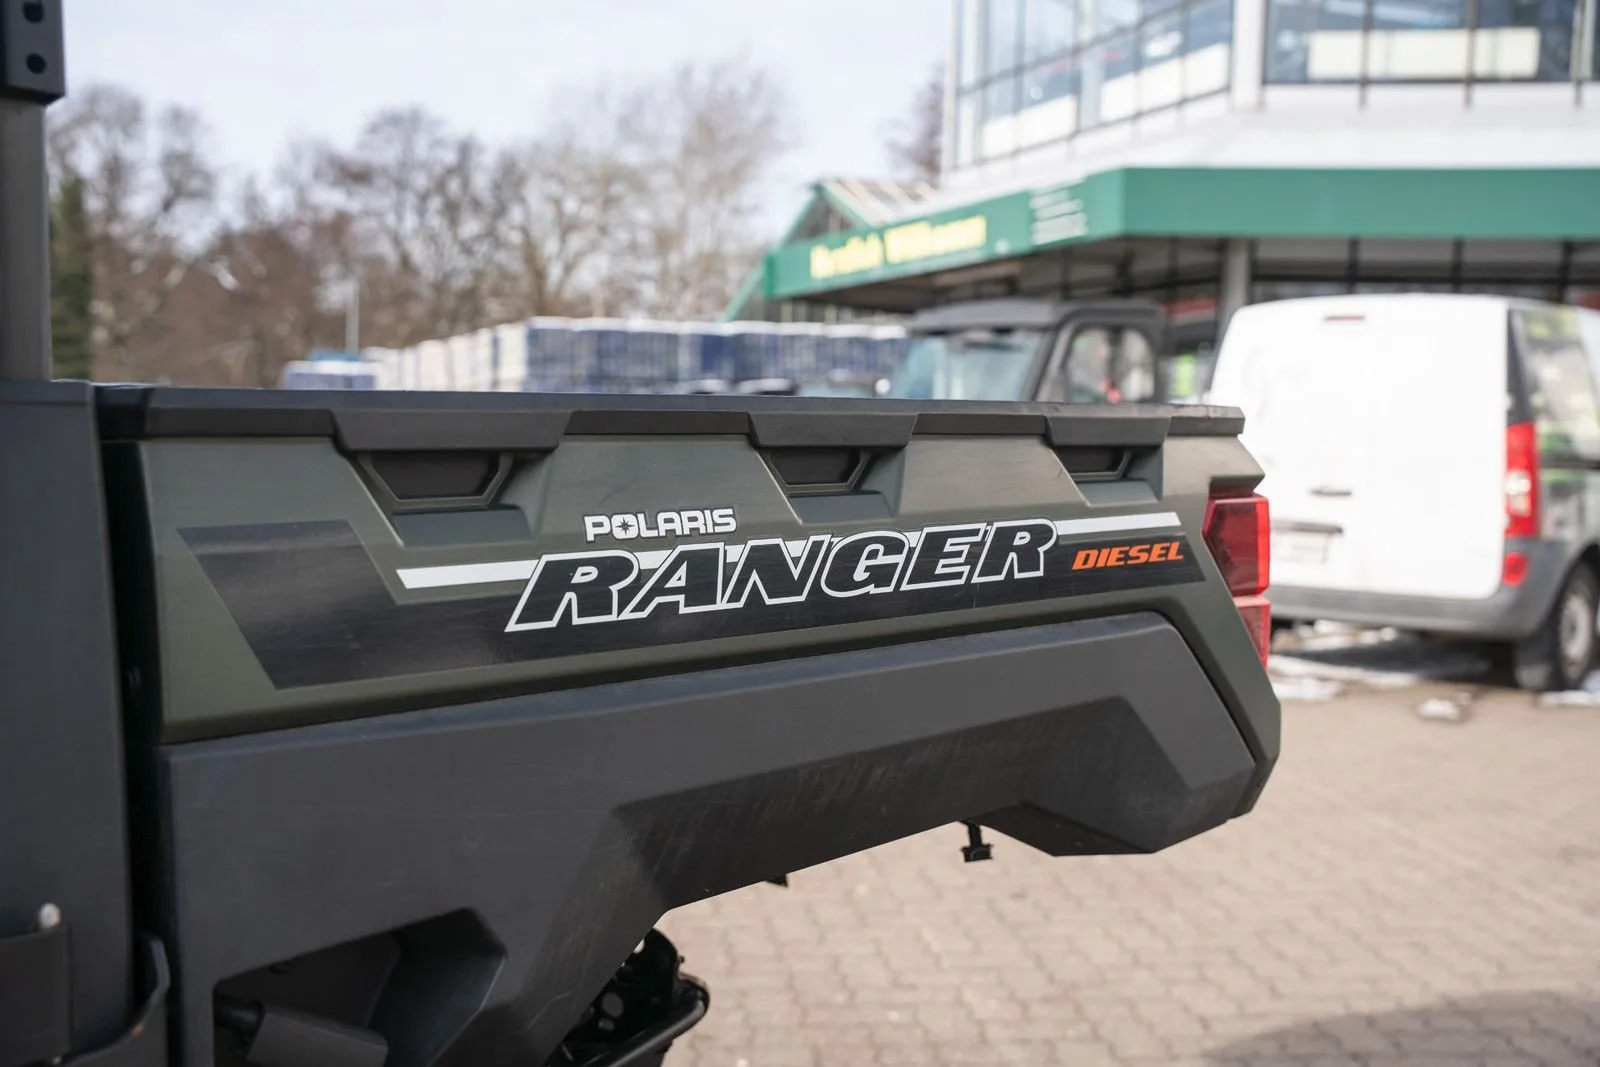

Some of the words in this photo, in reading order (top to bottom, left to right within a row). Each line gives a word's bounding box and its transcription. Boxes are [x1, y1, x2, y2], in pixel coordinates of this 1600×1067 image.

[584, 508, 737, 542] POLARIS
[504, 518, 1058, 633] RANGER
[1071, 541, 1184, 571] DIESEL
